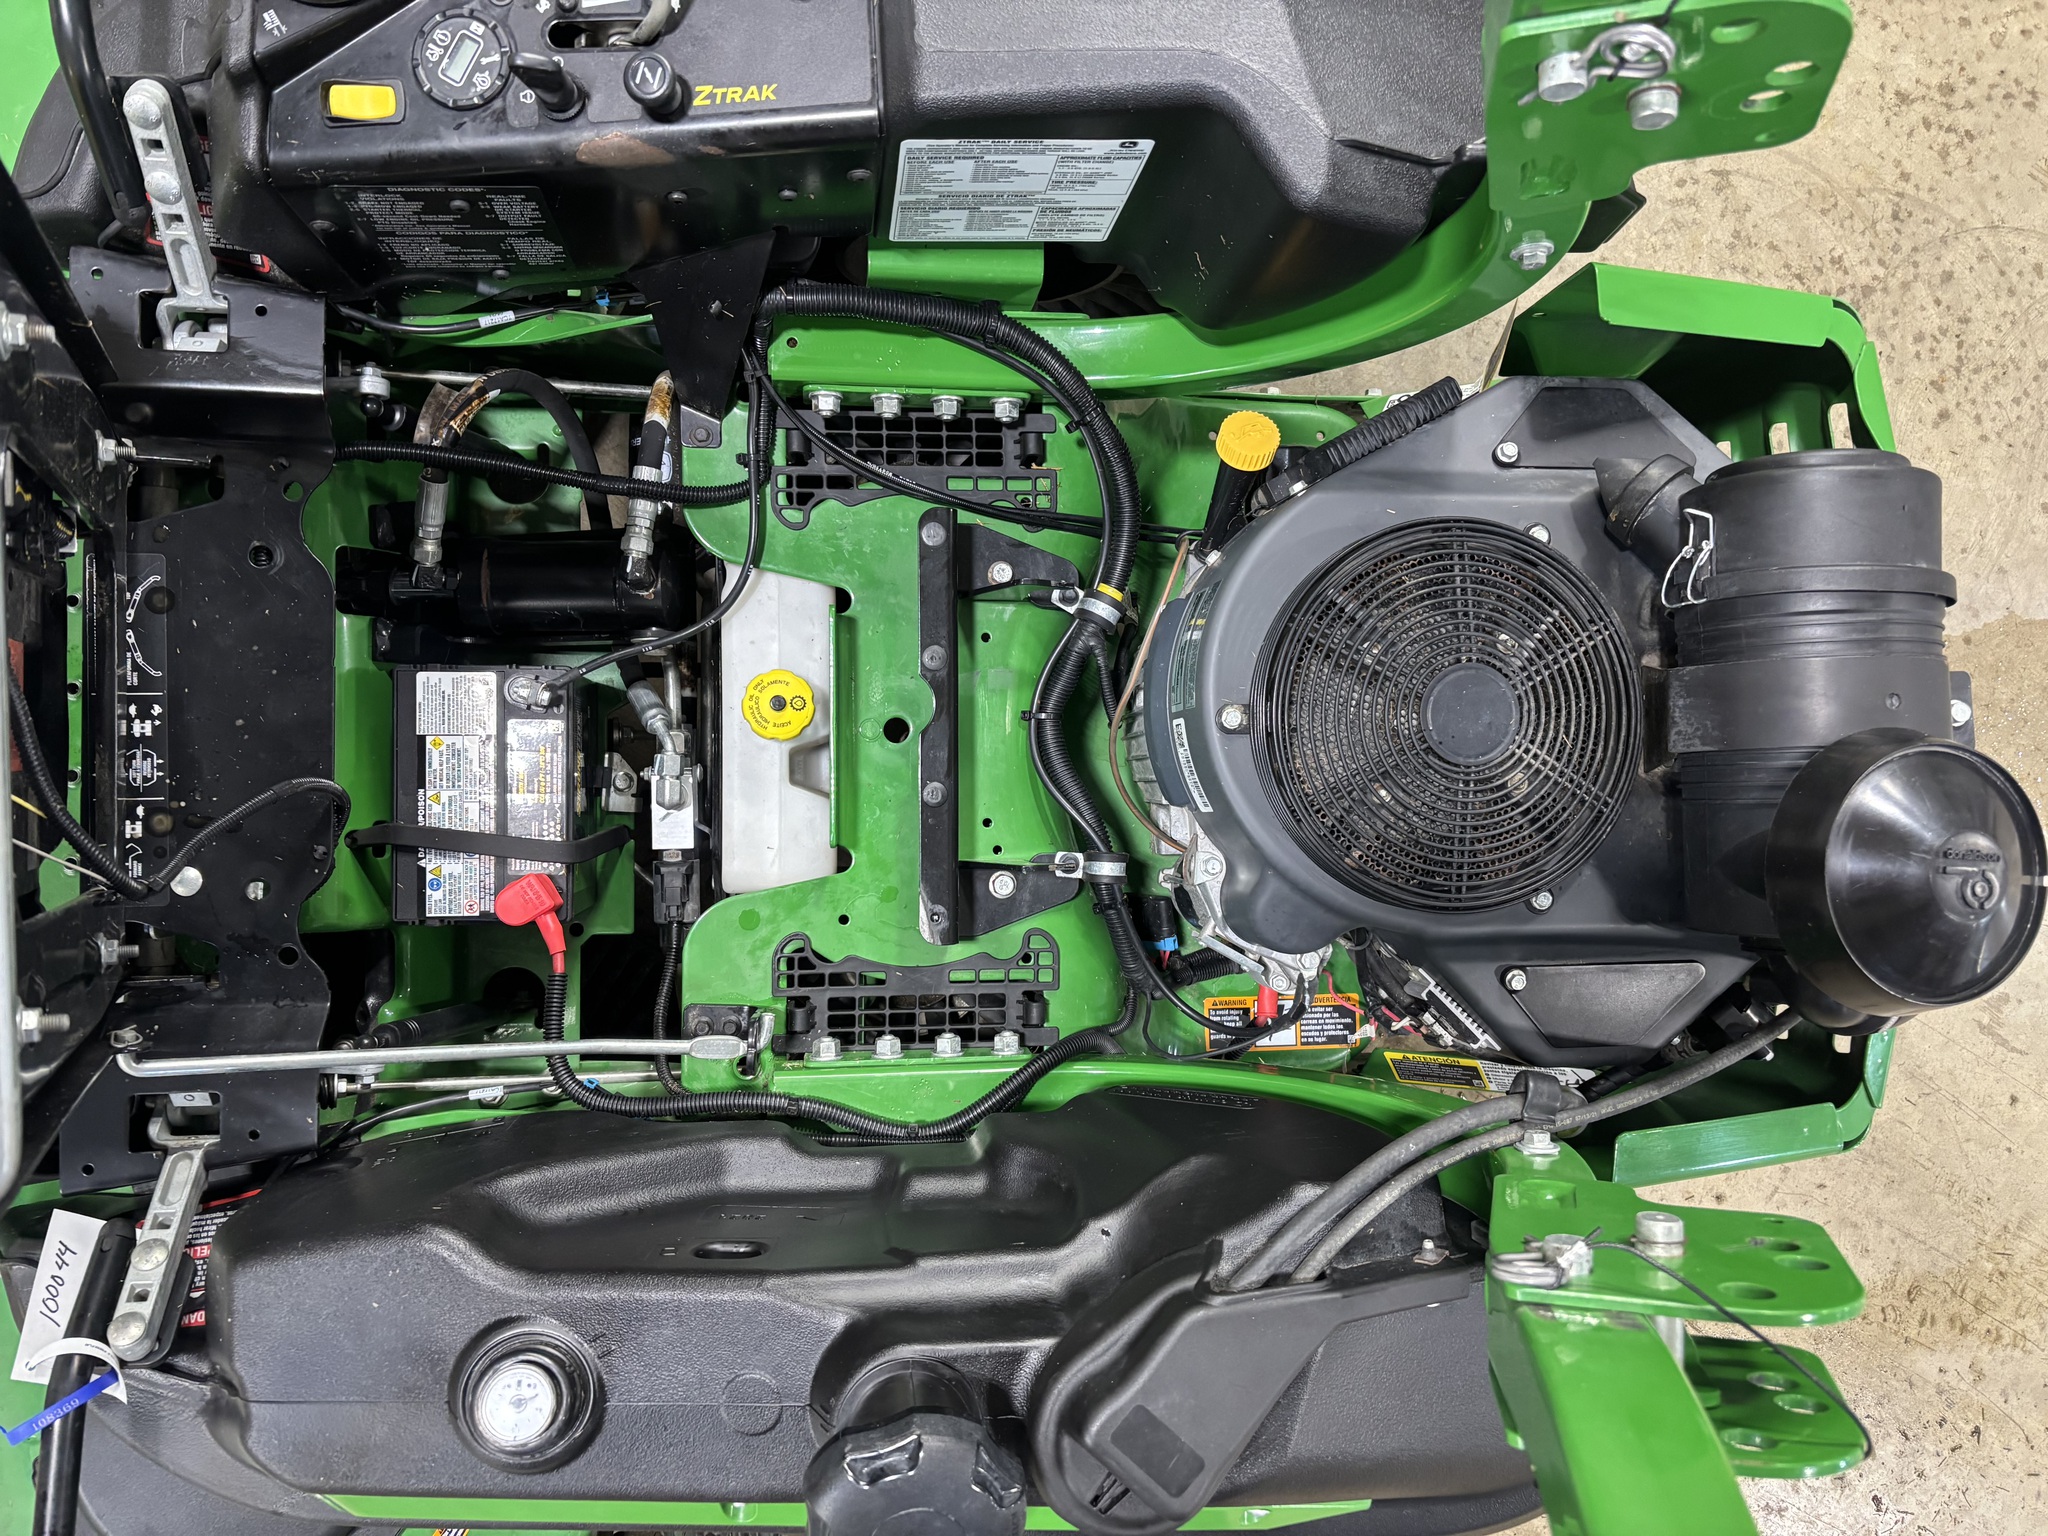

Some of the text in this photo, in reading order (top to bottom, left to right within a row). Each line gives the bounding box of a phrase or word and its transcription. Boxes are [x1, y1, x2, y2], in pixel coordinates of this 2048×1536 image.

[693, 84, 778, 107] ZTRAK
[753, 679, 765, 691] ONLY
[758, 679, 790, 693] SOLAMENTE
[748, 705, 768, 730] HYDRAULIC
[772, 720, 792, 728] ACEITE
[1943, 848, 2001, 863] donaldson
[1412, 1055, 1461, 1065] ATENCIÓN
[39, 1240, 79, 1328] 100044
[31, 1397, 80, 1431] 108369
